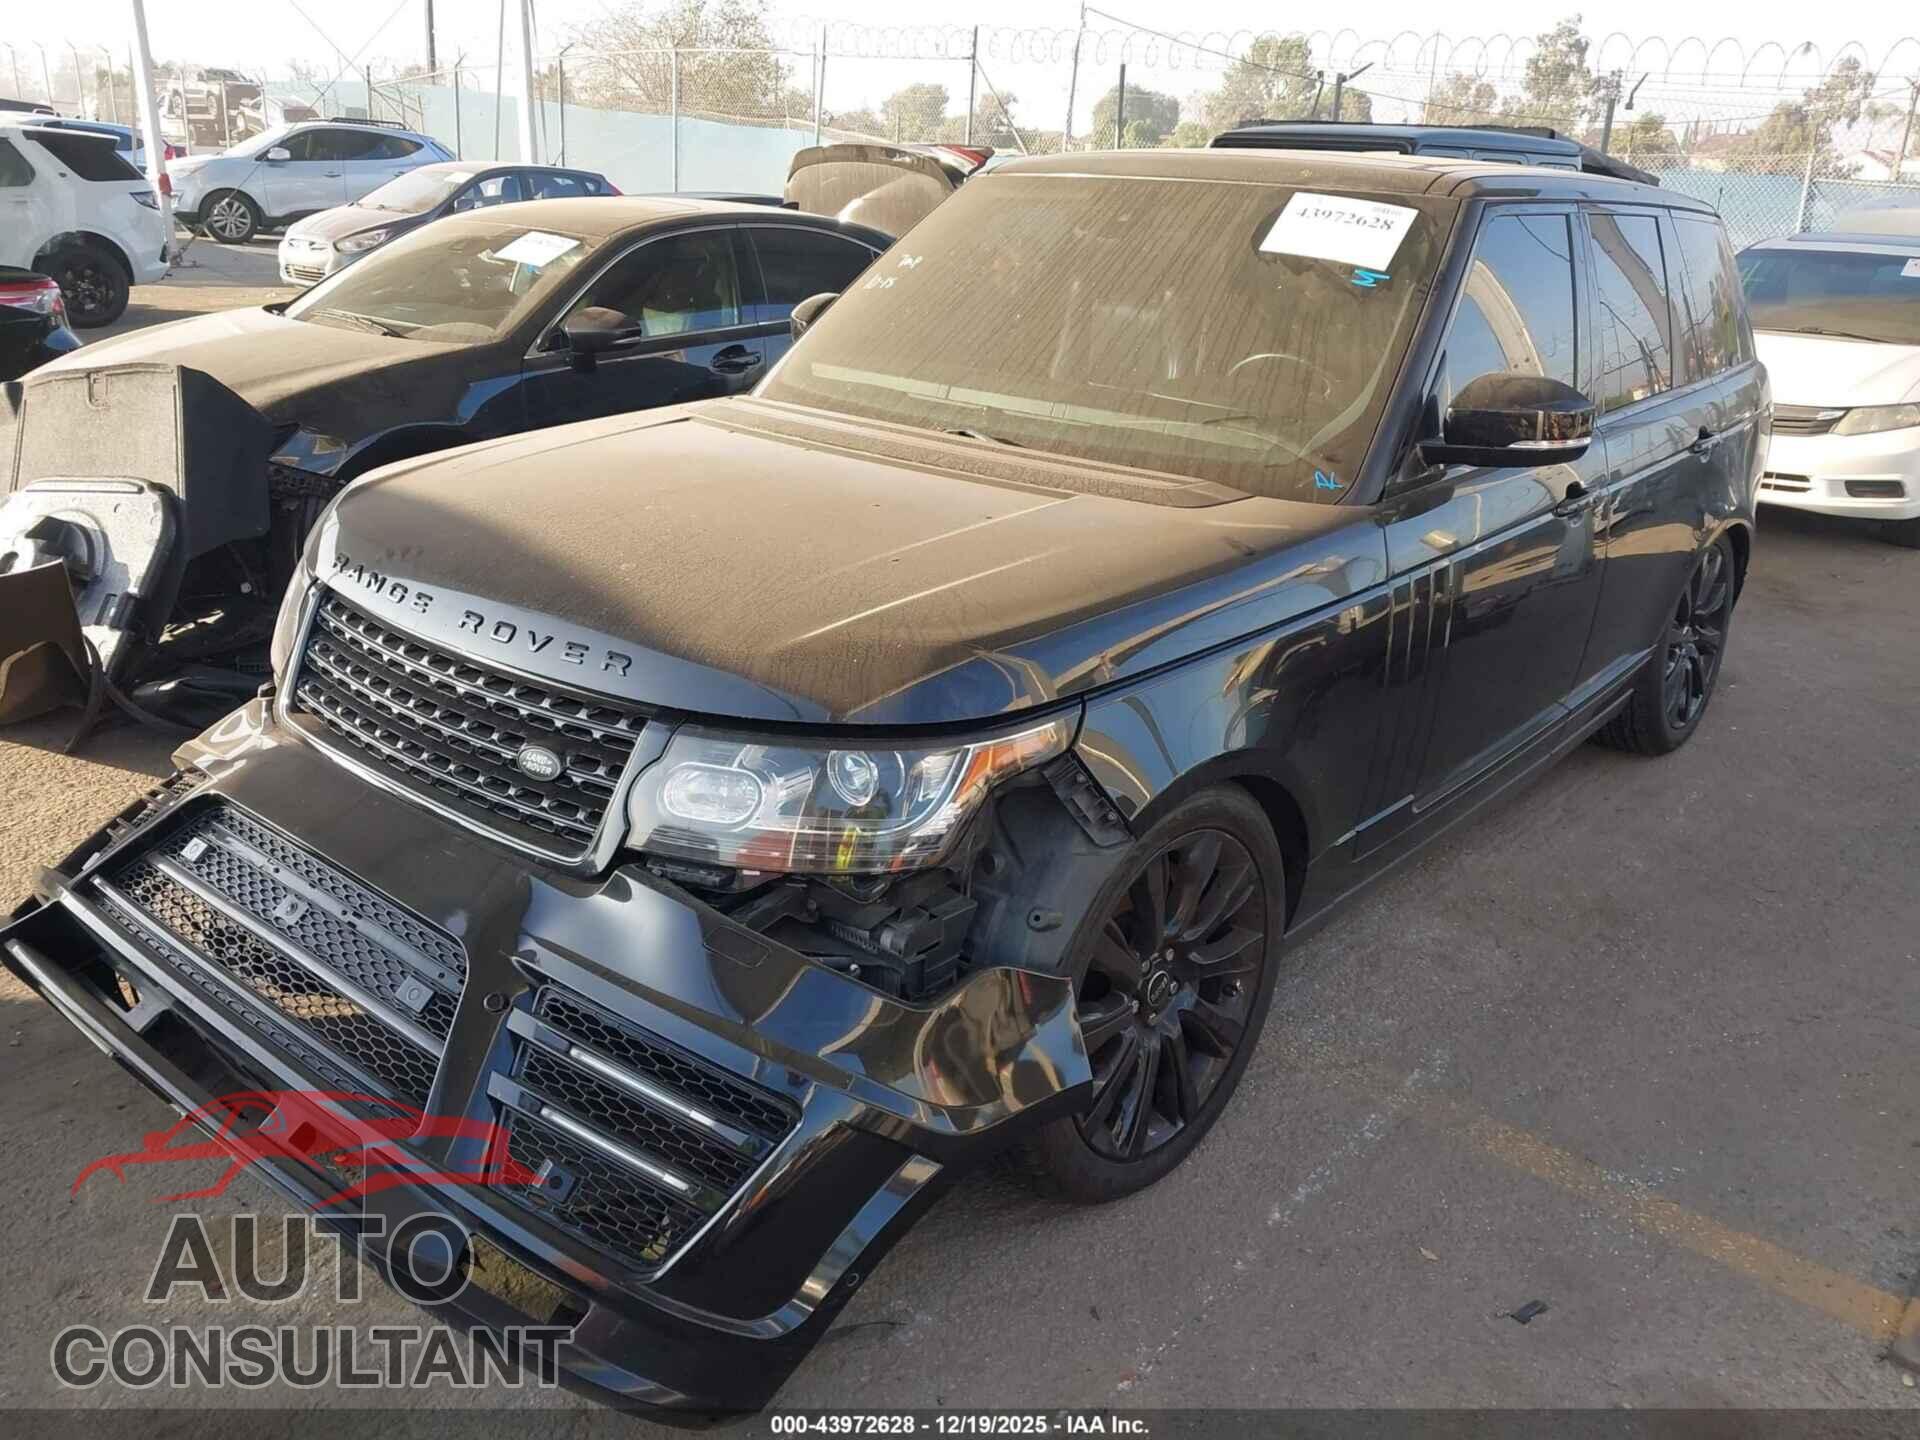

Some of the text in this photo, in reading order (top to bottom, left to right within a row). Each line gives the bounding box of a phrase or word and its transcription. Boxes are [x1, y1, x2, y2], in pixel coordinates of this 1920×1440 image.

[1297, 206, 1394, 231] 43972628
[333, 553, 632, 677] RANGE ROVER
